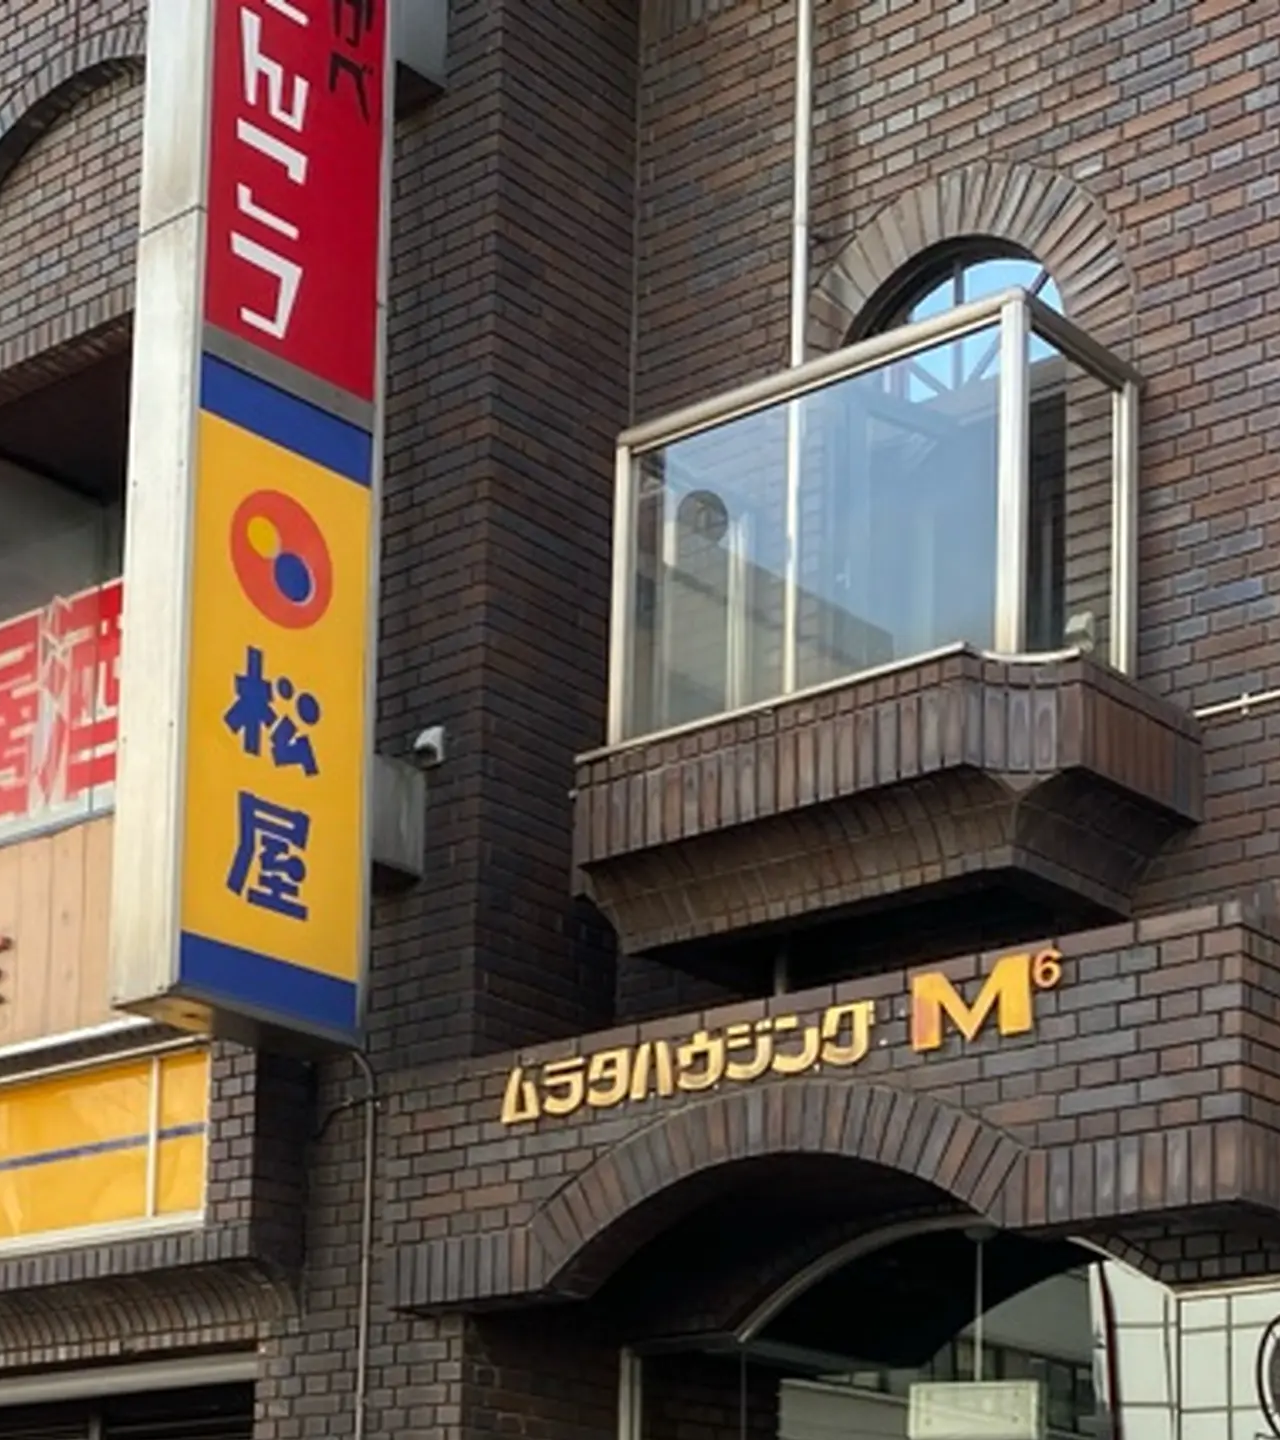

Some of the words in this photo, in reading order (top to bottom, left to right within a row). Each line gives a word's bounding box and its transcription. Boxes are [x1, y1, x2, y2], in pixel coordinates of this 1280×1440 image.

[224, 645, 321, 922] 松屋
[500, 1000, 876, 1125] ムラタハウジング
